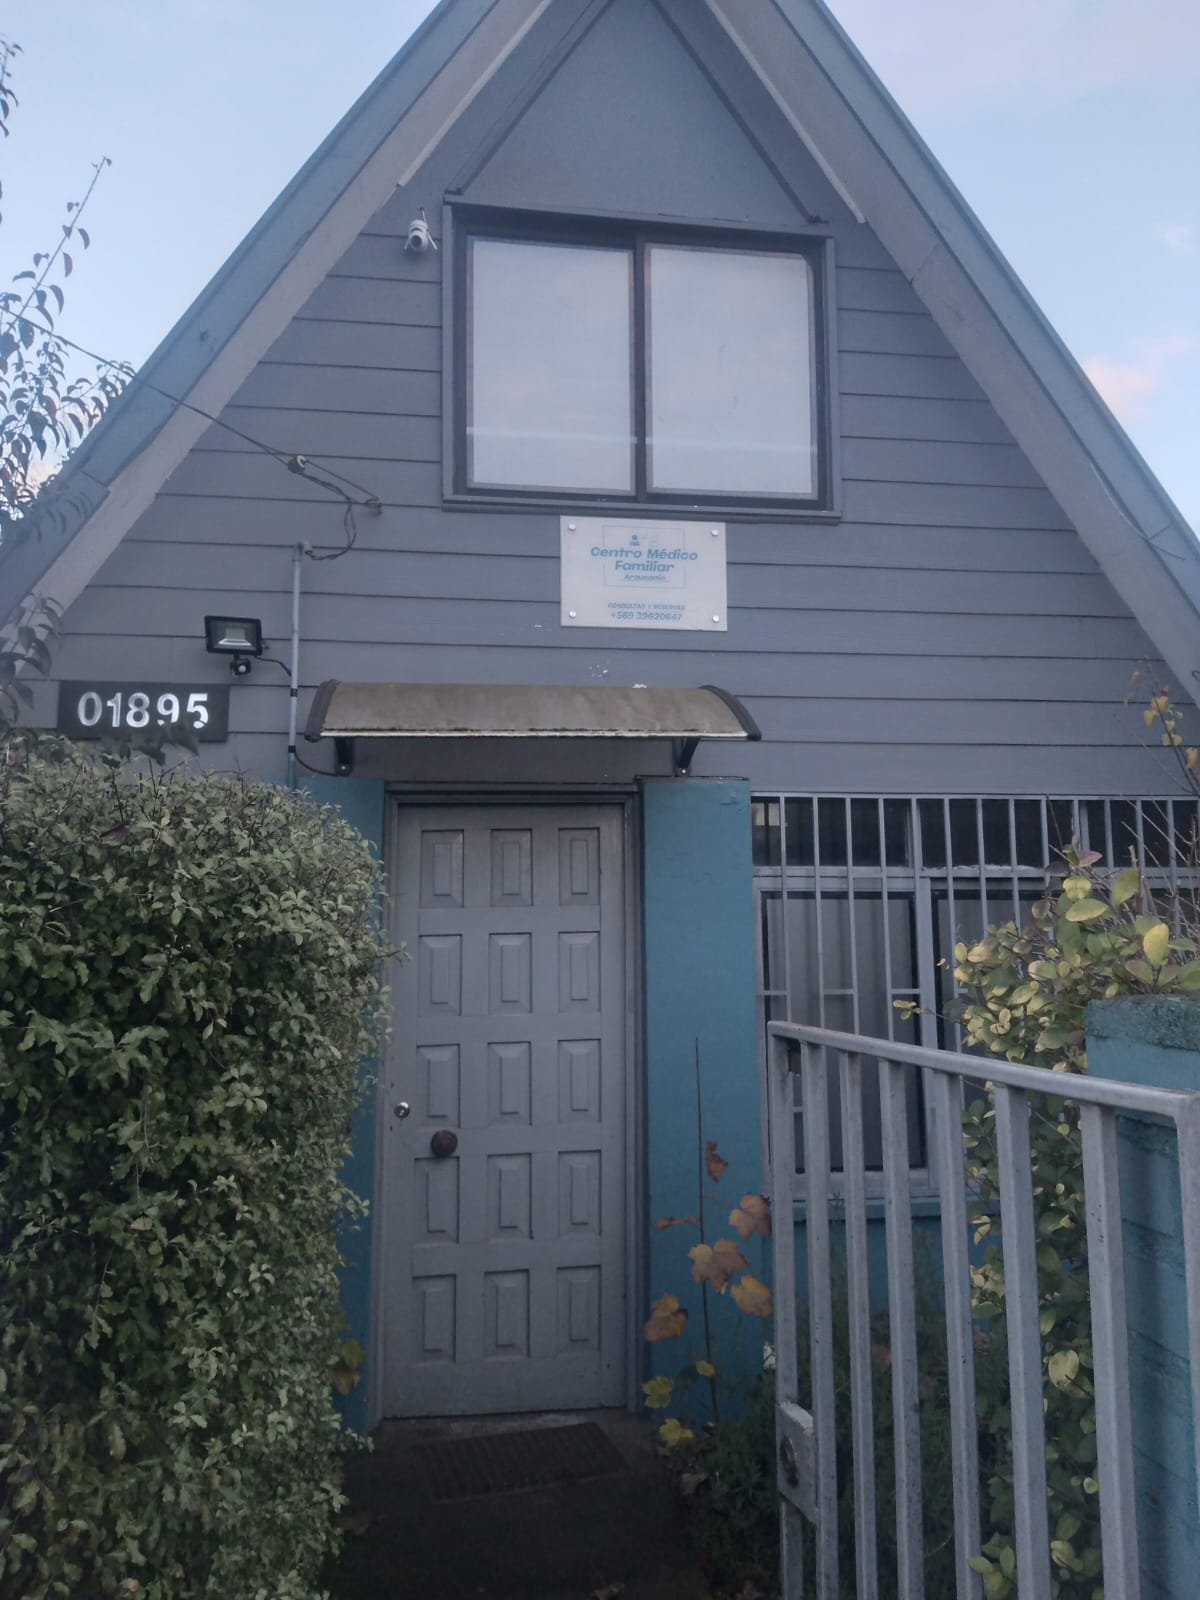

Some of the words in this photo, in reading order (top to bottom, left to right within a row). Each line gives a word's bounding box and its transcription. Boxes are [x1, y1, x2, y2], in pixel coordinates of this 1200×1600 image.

[590, 546, 642, 559] Centro
[647, 548, 698, 561] Médico
[615, 560, 674, 573] Familiar
[611, 611, 634, 620] +569
[77, 691, 208, 729] 01895
